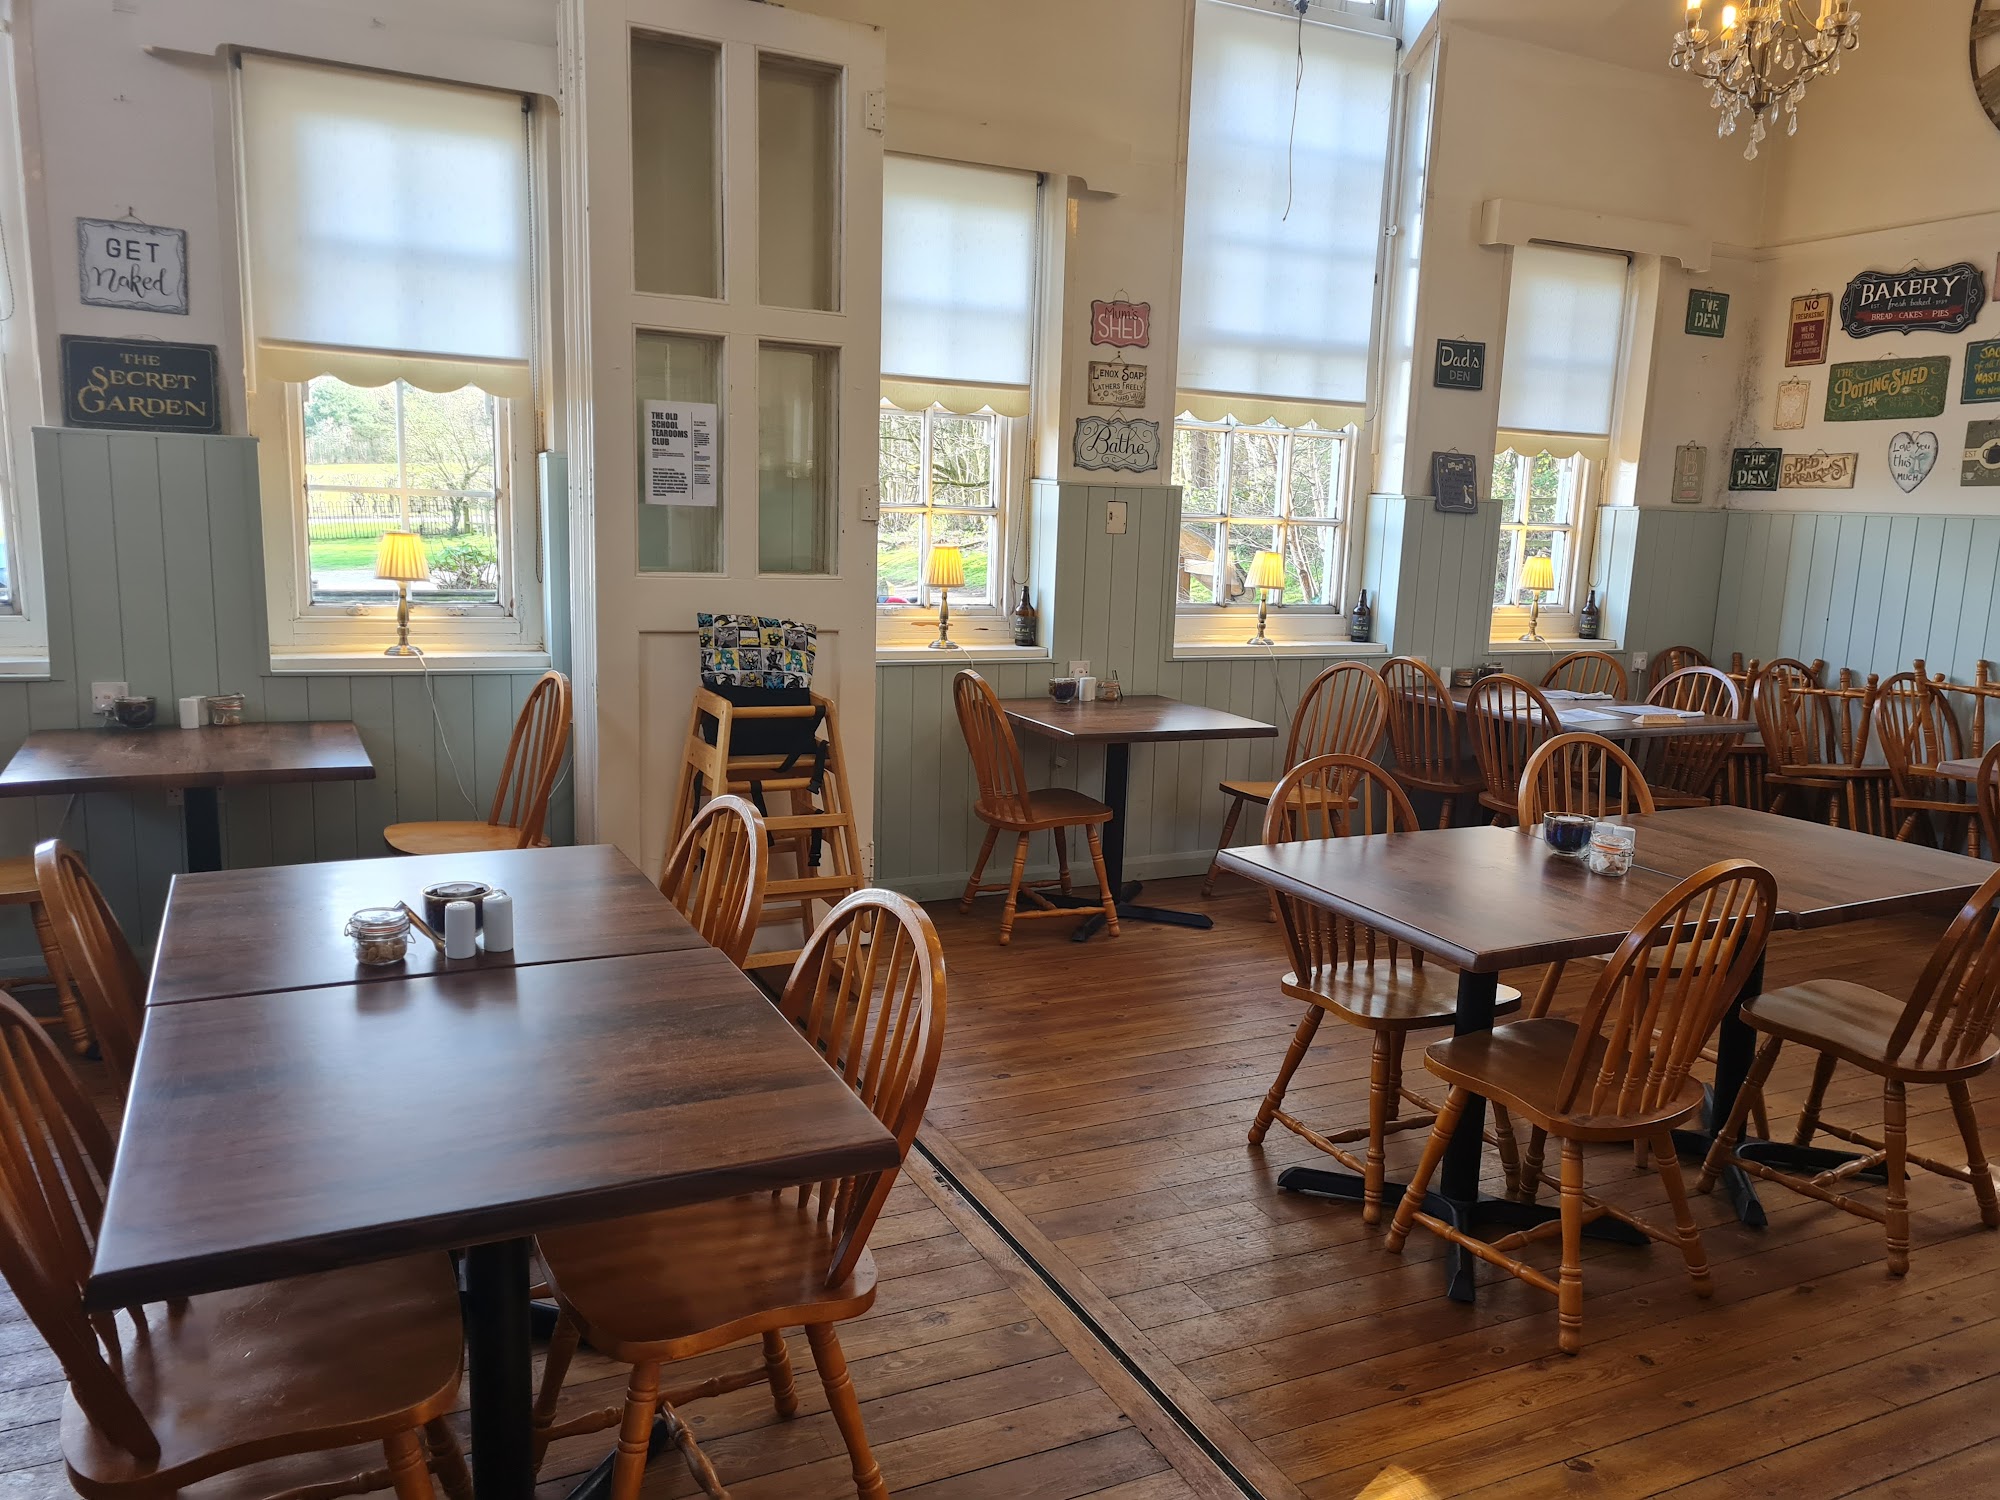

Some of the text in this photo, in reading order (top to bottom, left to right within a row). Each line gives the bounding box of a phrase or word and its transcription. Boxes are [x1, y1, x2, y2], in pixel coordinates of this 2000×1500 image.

[106, 238, 159, 262] GET
[1860, 275, 1960, 306] BAKERY
[1803, 300, 1819, 311] NO
[1104, 307, 1138, 320] Mum's
[1871, 309, 1950, 321] BREAD CAKES PIES
[1098, 314, 1144, 339] SHED
[1694, 312, 1720, 329] DEN
[120, 353, 160, 366] THE
[1441, 345, 1480, 368] Dad's
[1450, 370, 1470, 381] DEN
[1836, 368, 1854, 378] THE
[652, 421, 678, 429] SCHOOL
[651, 429, 688, 438] TEAROOMS
[1086, 426, 1146, 455] Bathe
[1744, 455, 1766, 465] THE
[1894, 455, 1912, 468] this
[1737, 470, 1769, 485] DEN
[1897, 473, 1919, 481] MUCH
